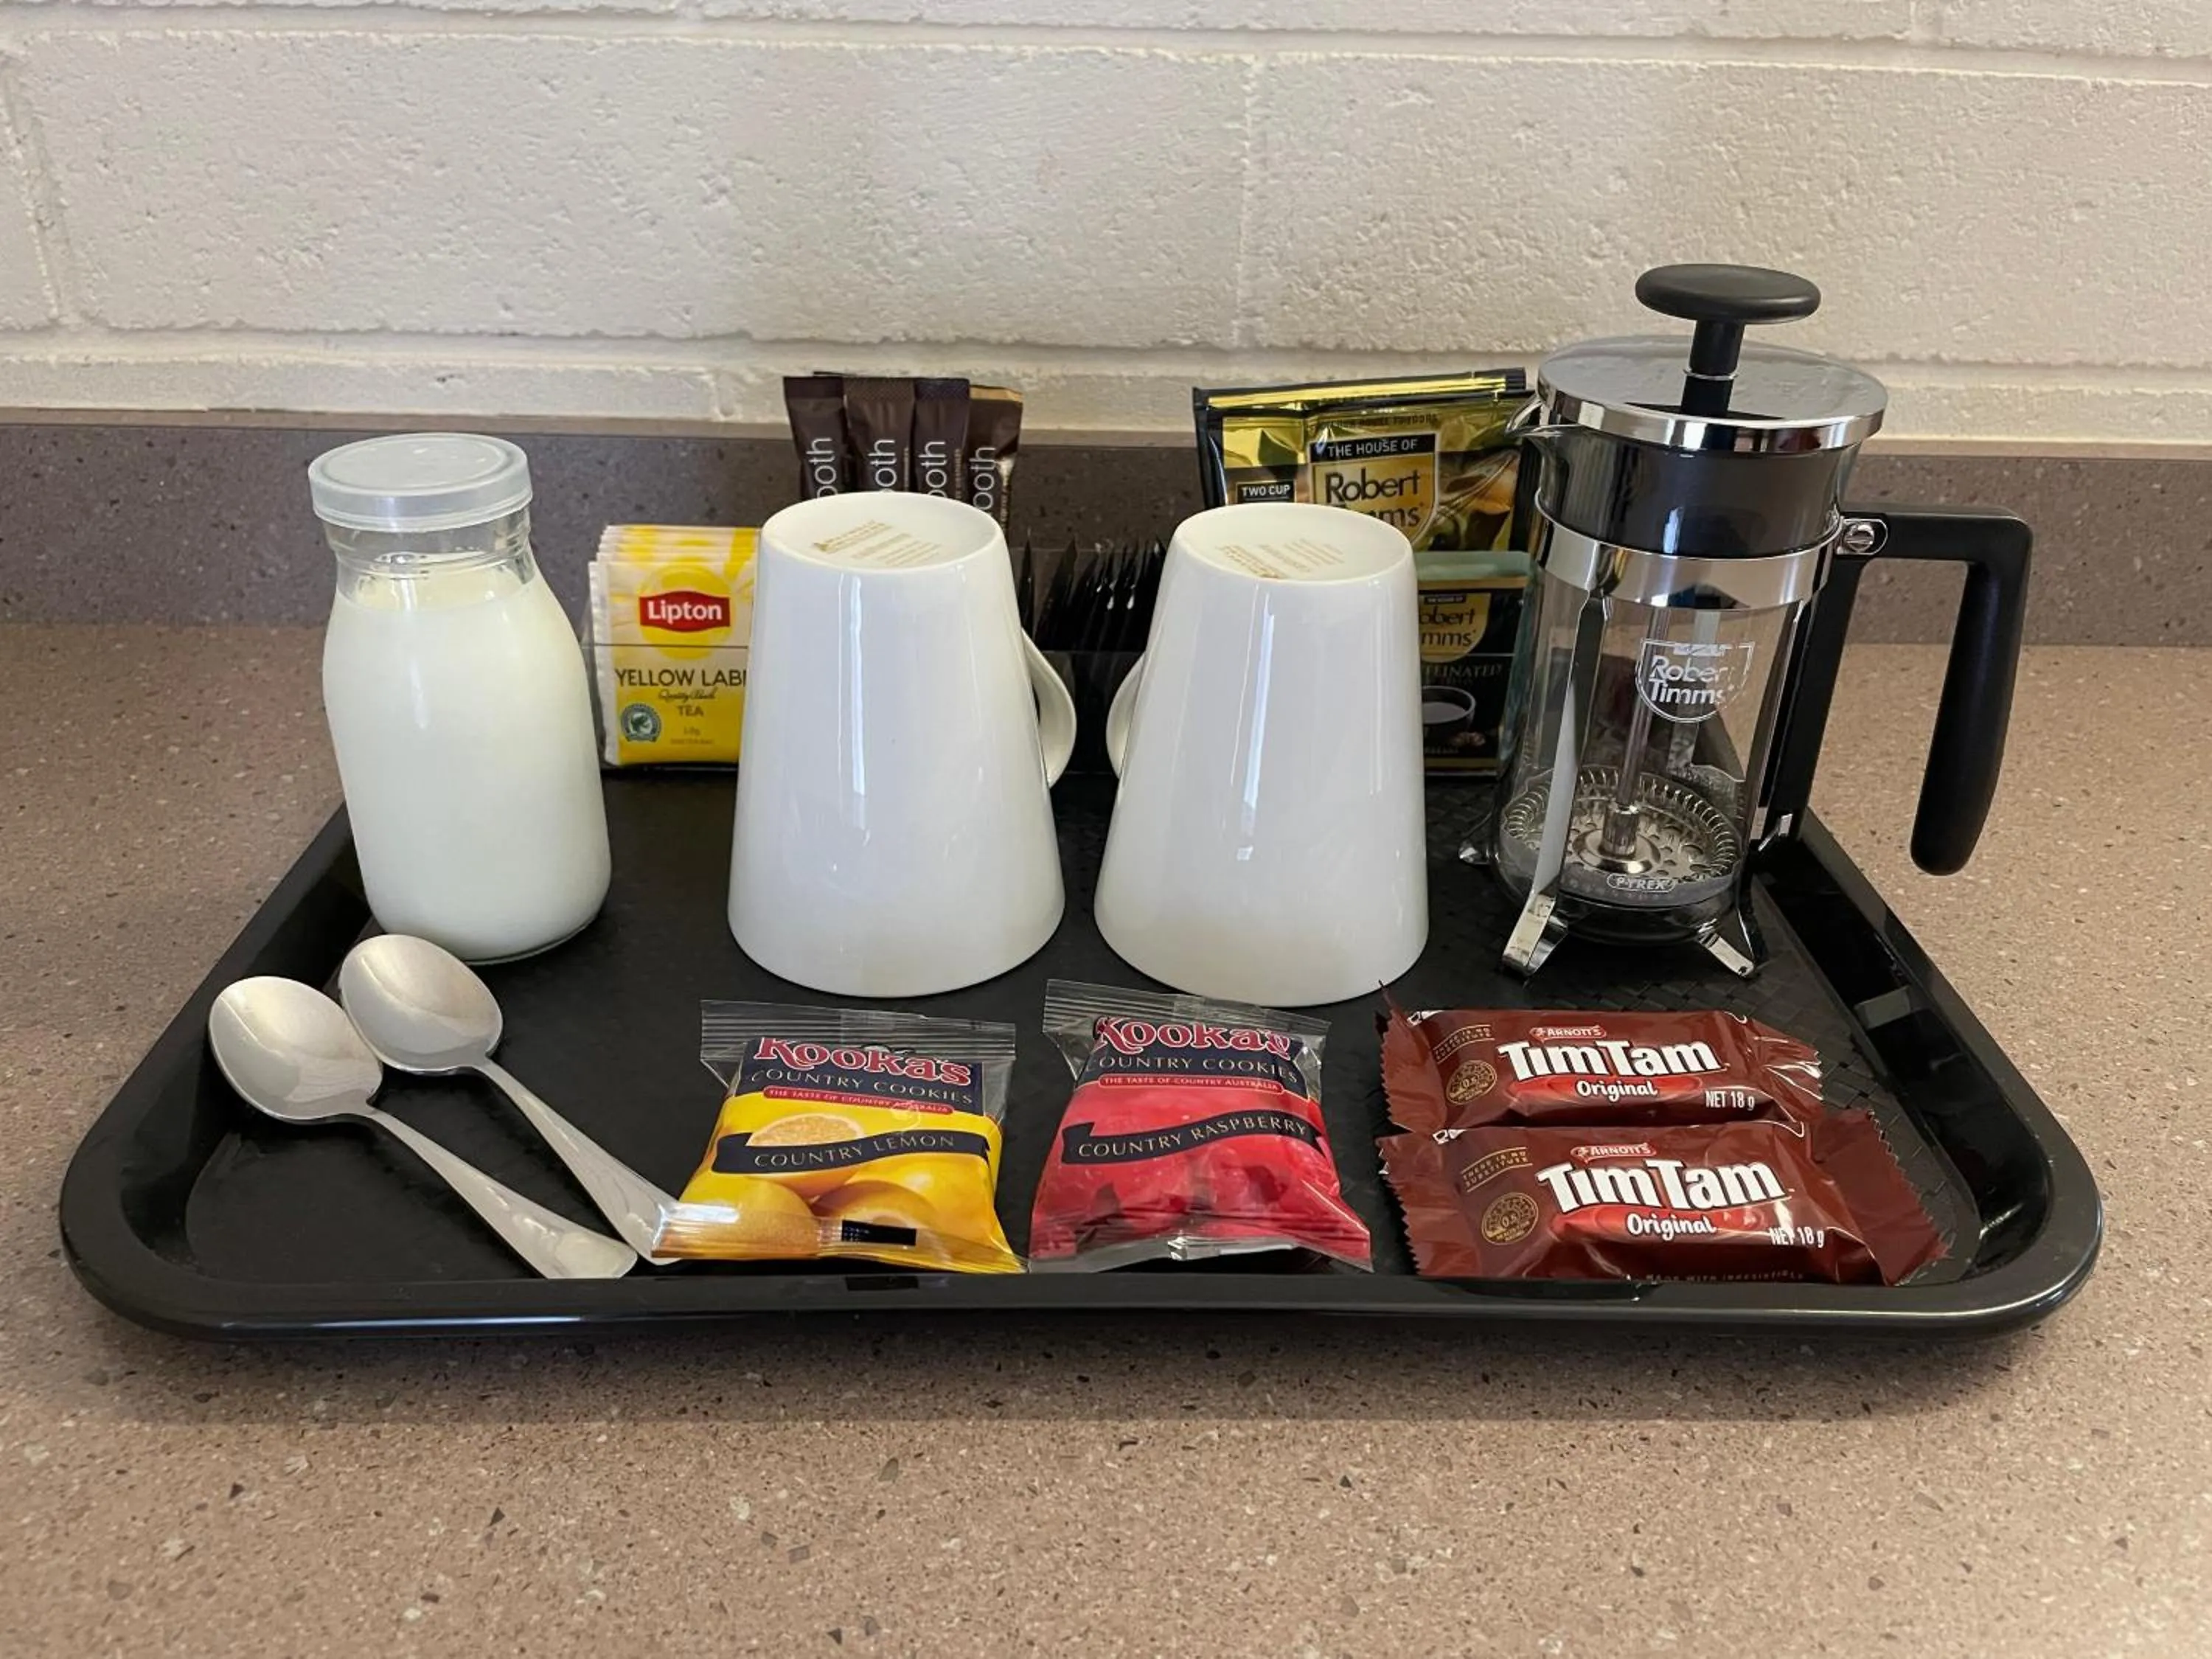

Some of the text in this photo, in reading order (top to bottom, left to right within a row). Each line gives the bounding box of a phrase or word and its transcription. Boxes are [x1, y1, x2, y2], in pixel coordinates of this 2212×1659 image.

[1327, 439, 1418, 457] THE HOUSE OF
[1241, 484, 1290, 496] TWO CUP
[1325, 466, 1420, 504] Robert
[647, 599, 722, 625] Lipton
[1419, 605, 1475, 625] obert
[614, 669, 747, 687] YELLOW LAB
[676, 705, 704, 717] TEA
[1616, 877, 1665, 890] PYREX
[1203, 1058, 1297, 1083] COOKIES
[751, 1068, 973, 1104] COUNTRY COOKIES
[1173, 1077, 1222, 1086] COUNTRY
[1225, 1078, 1279, 1091] AUSTRALIA
[1576, 1079, 1658, 1102] Original
[1705, 1091, 1755, 1111] NET 18 g
[1079, 1117, 1307, 1157] COUNTRY RASPBERRY
[754, 1133, 954, 1168] COUNTRY LEMON
[1627, 1213, 1717, 1241] Original
[1770, 1226, 1825, 1248] NET 18 g
